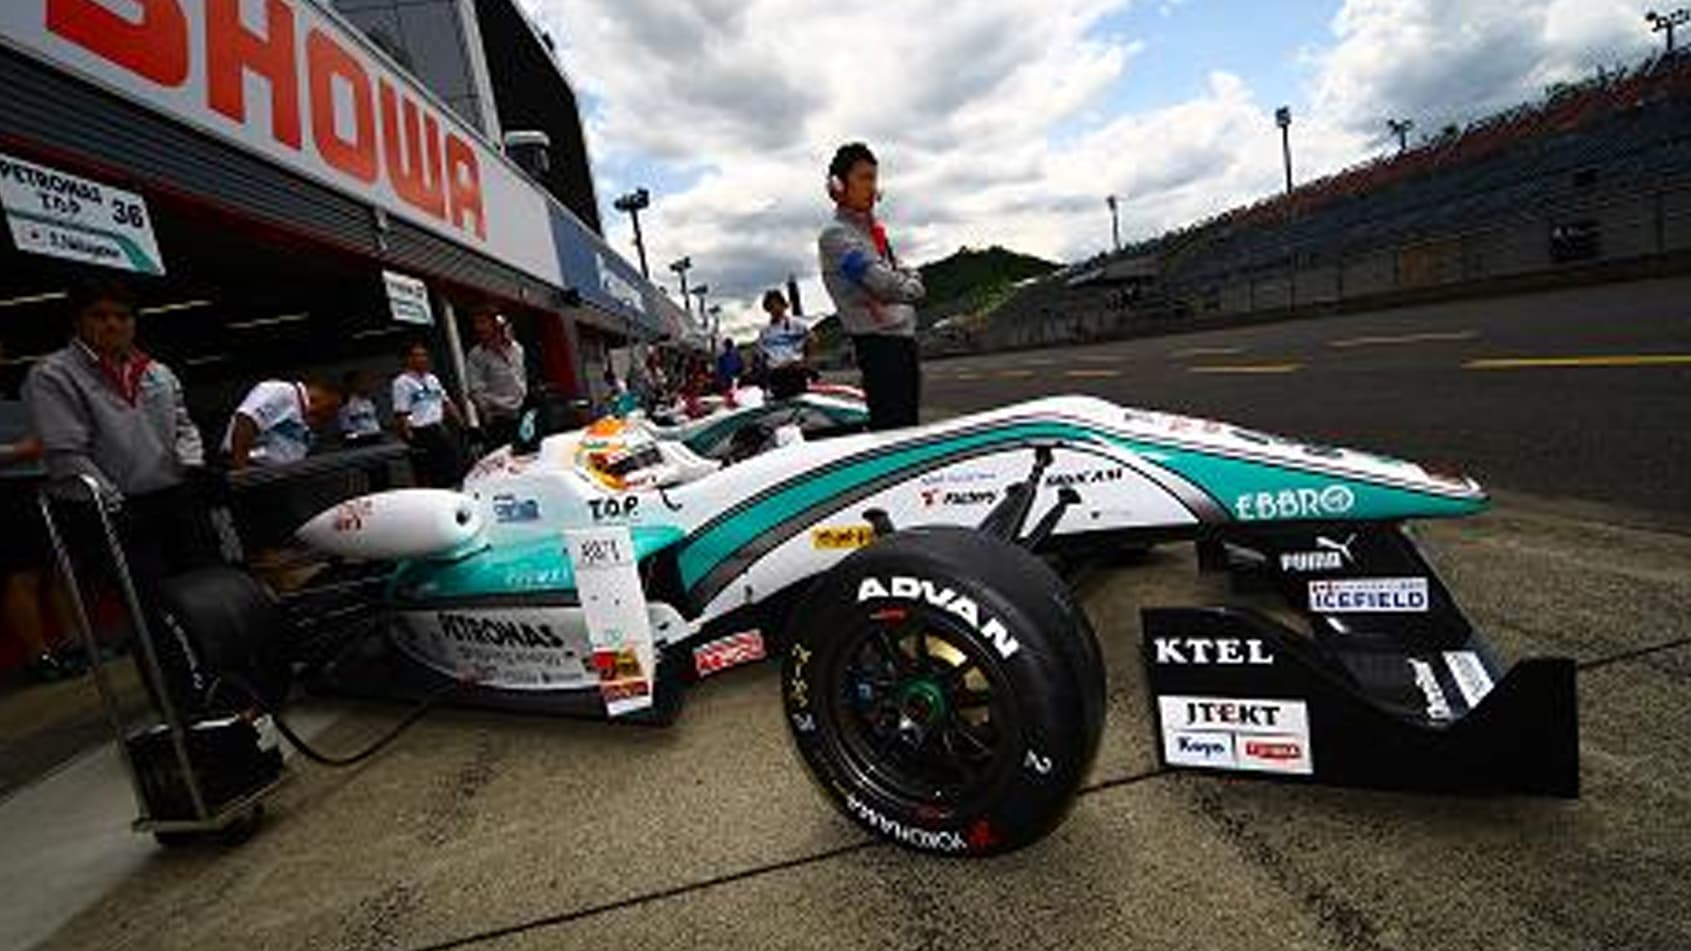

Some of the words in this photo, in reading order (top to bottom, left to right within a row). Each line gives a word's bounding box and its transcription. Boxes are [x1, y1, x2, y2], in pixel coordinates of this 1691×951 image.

[112, 198, 144, 229] 36
[1236, 484, 1355, 520] EBBRO
[1315, 592, 1425, 608] ICEFIELD
[857, 576, 1019, 660] ADVAN
[1154, 637, 1274, 665] KTEL
[1187, 702, 1280, 726] JTEKT
